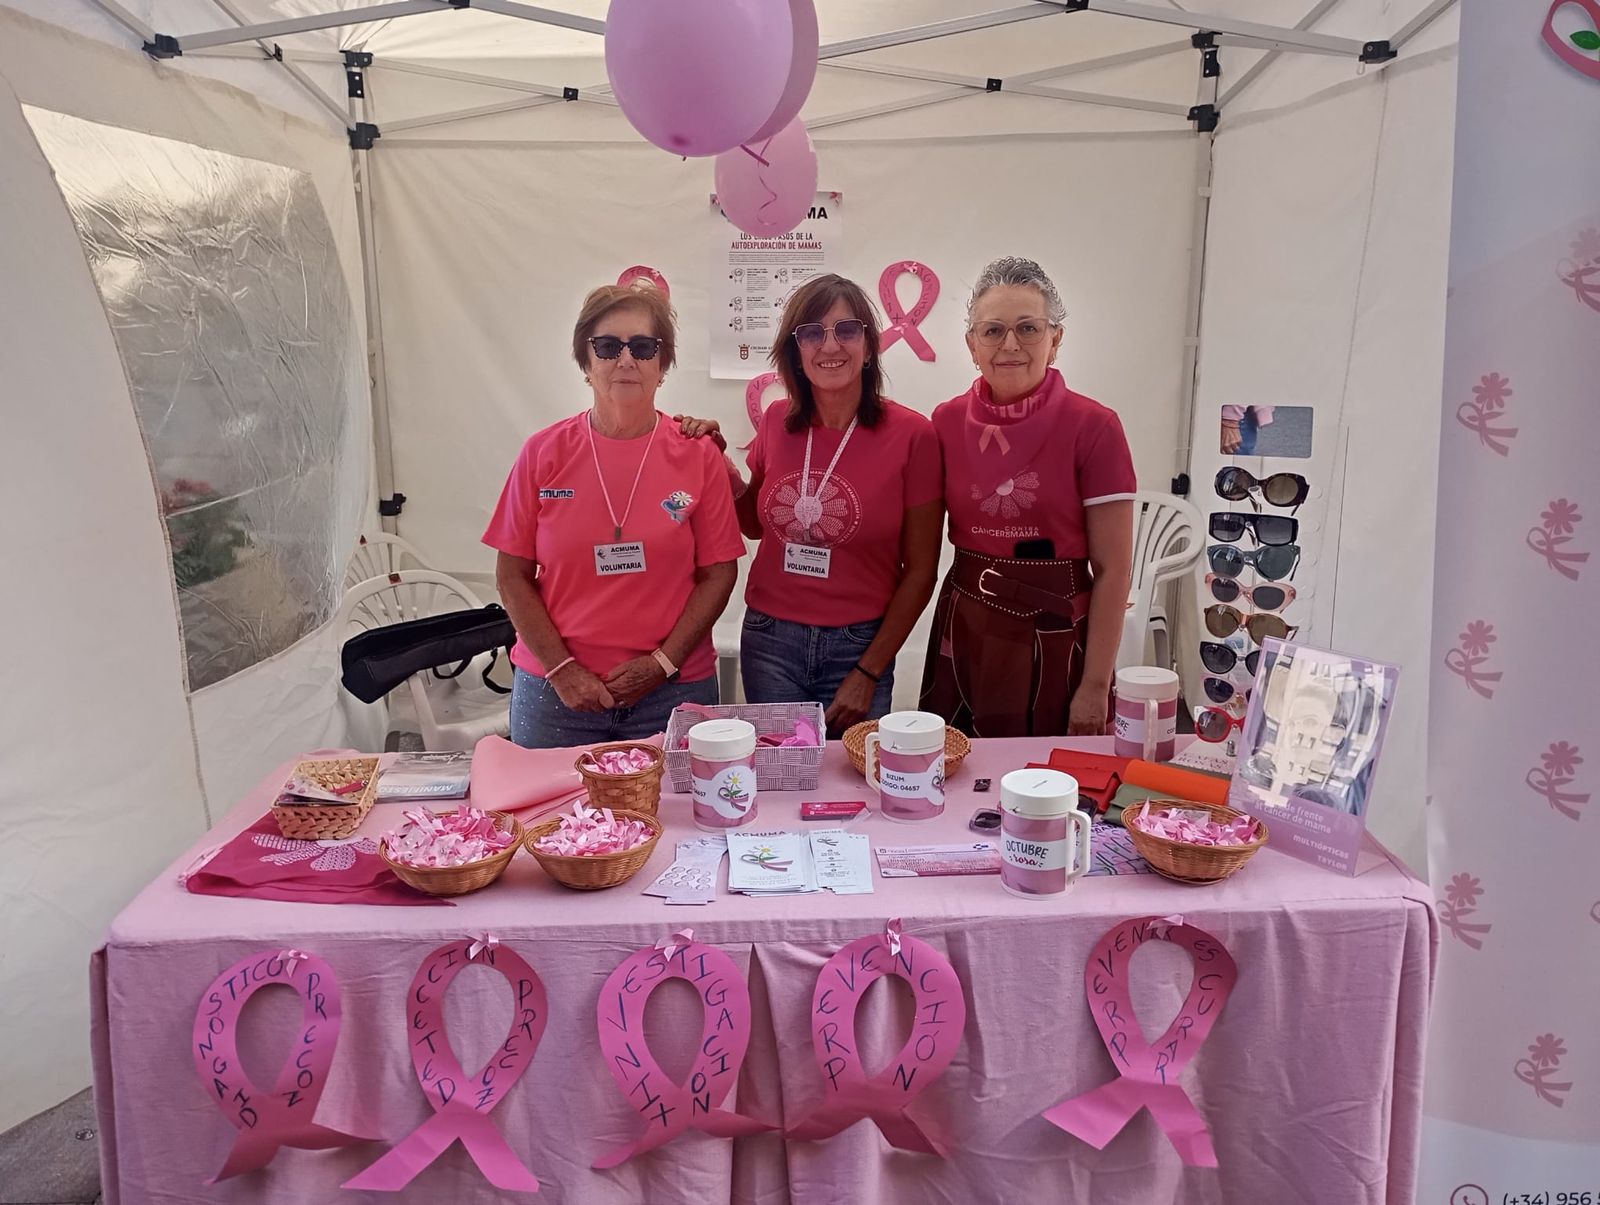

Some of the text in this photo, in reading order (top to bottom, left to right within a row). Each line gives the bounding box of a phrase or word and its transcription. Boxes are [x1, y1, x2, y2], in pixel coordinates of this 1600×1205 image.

[796, 232, 804, 240] DE
[805, 232, 813, 240] LA
[731, 240, 822, 250] AUTOEXPLORACIÓN DE MAMAS
[611, 545, 640, 553] ACMUMA
[799, 548, 827, 558] ACMUMA
[600, 562, 642, 572] VOLUNTARIA
[787, 562, 826, 575] VOLUNTARIA
[886, 772, 905, 782] BIZUM
[1297, 806, 1324, 823] frente
[1304, 820, 1331, 834] mama
[1006, 840, 1049, 859] OCTUBRE
[1194, 940, 1220, 962] ES
[816, 945, 948, 1092] PREVENCIÓN
[475, 979, 536, 1110] PRECOZ
[1503, 1191, 1549, 1205] (+34)
[1556, 1192, 1592, 1205] 956
